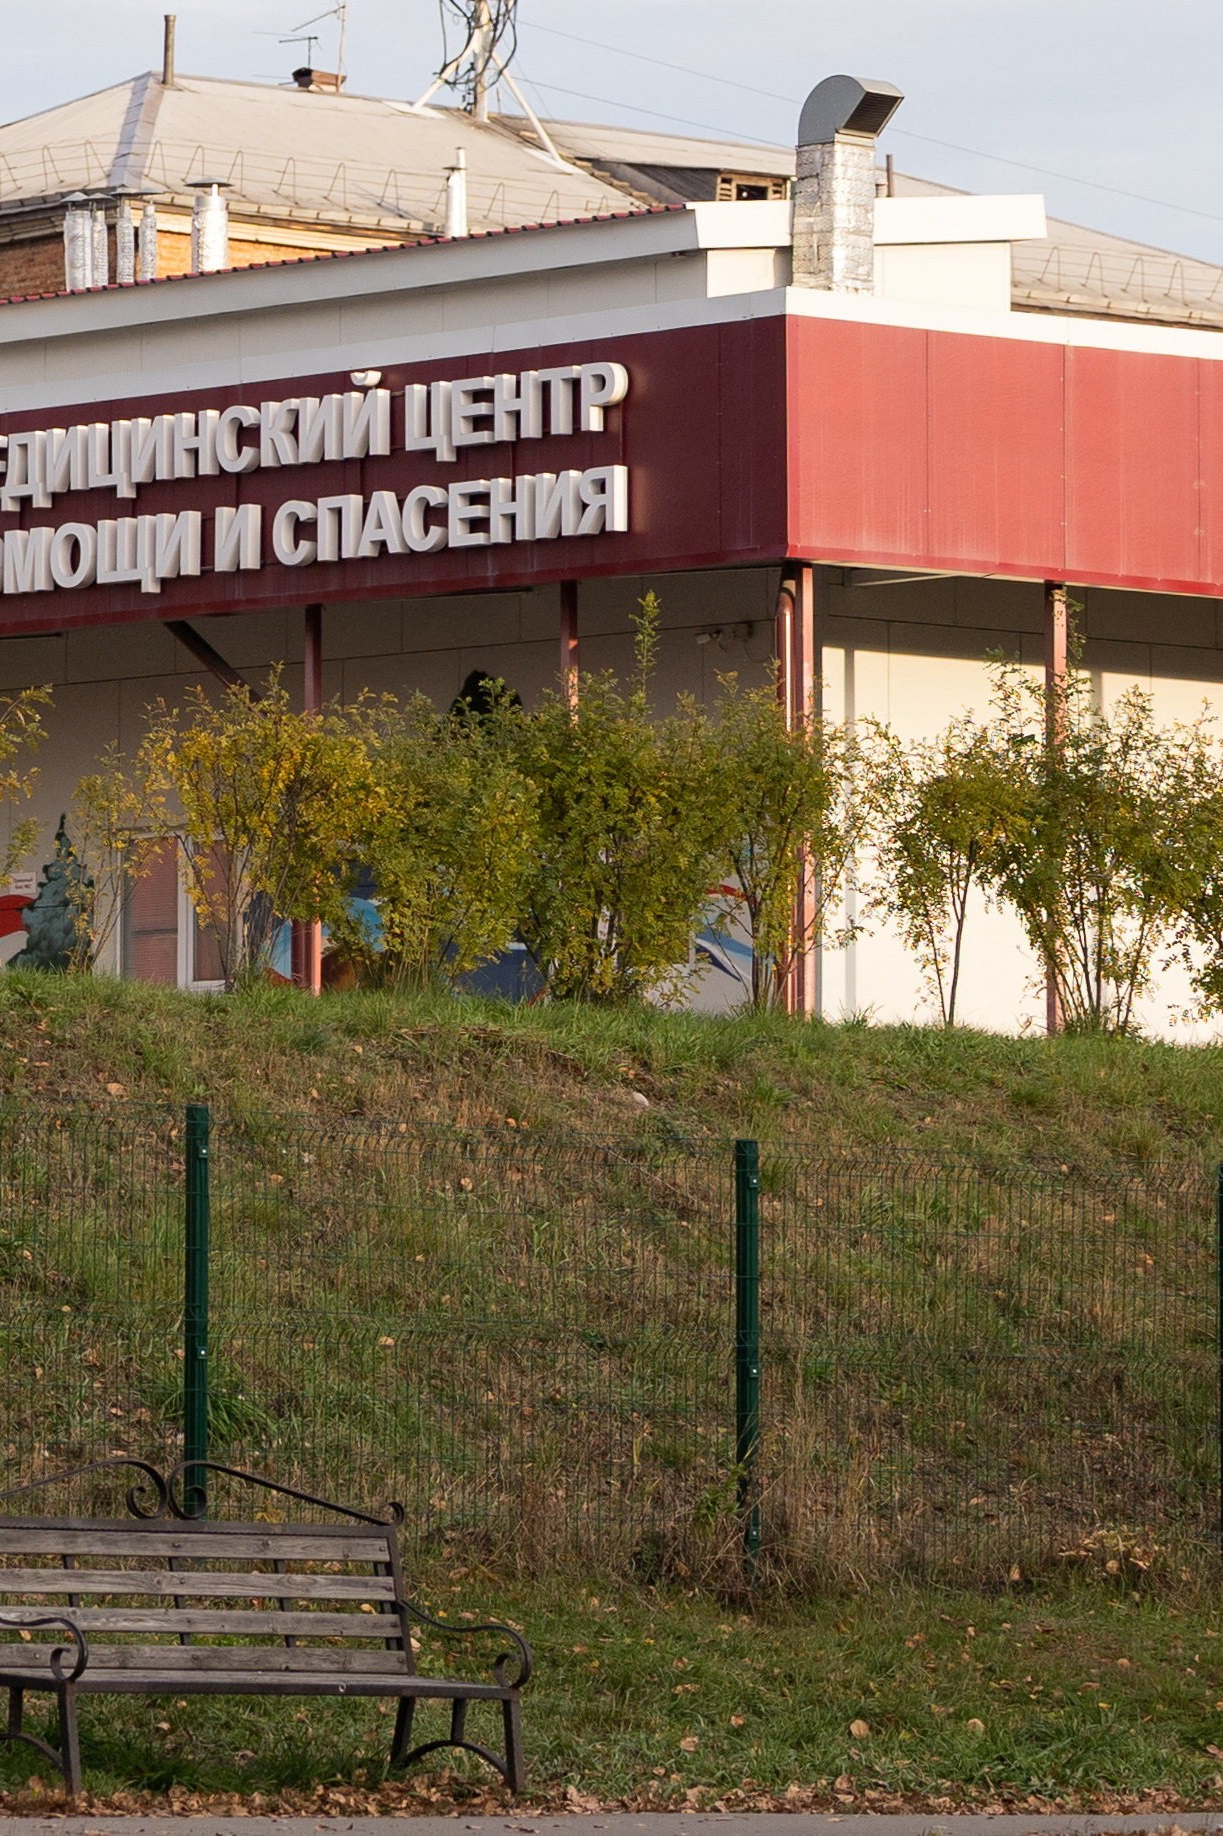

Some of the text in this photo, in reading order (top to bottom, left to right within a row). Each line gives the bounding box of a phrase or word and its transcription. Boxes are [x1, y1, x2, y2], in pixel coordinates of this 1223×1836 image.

[404, 362, 628, 462] ЦЕНТР
[214, 503, 262, 572] И
[272, 464, 628, 567] СПАСЕНИЯ
